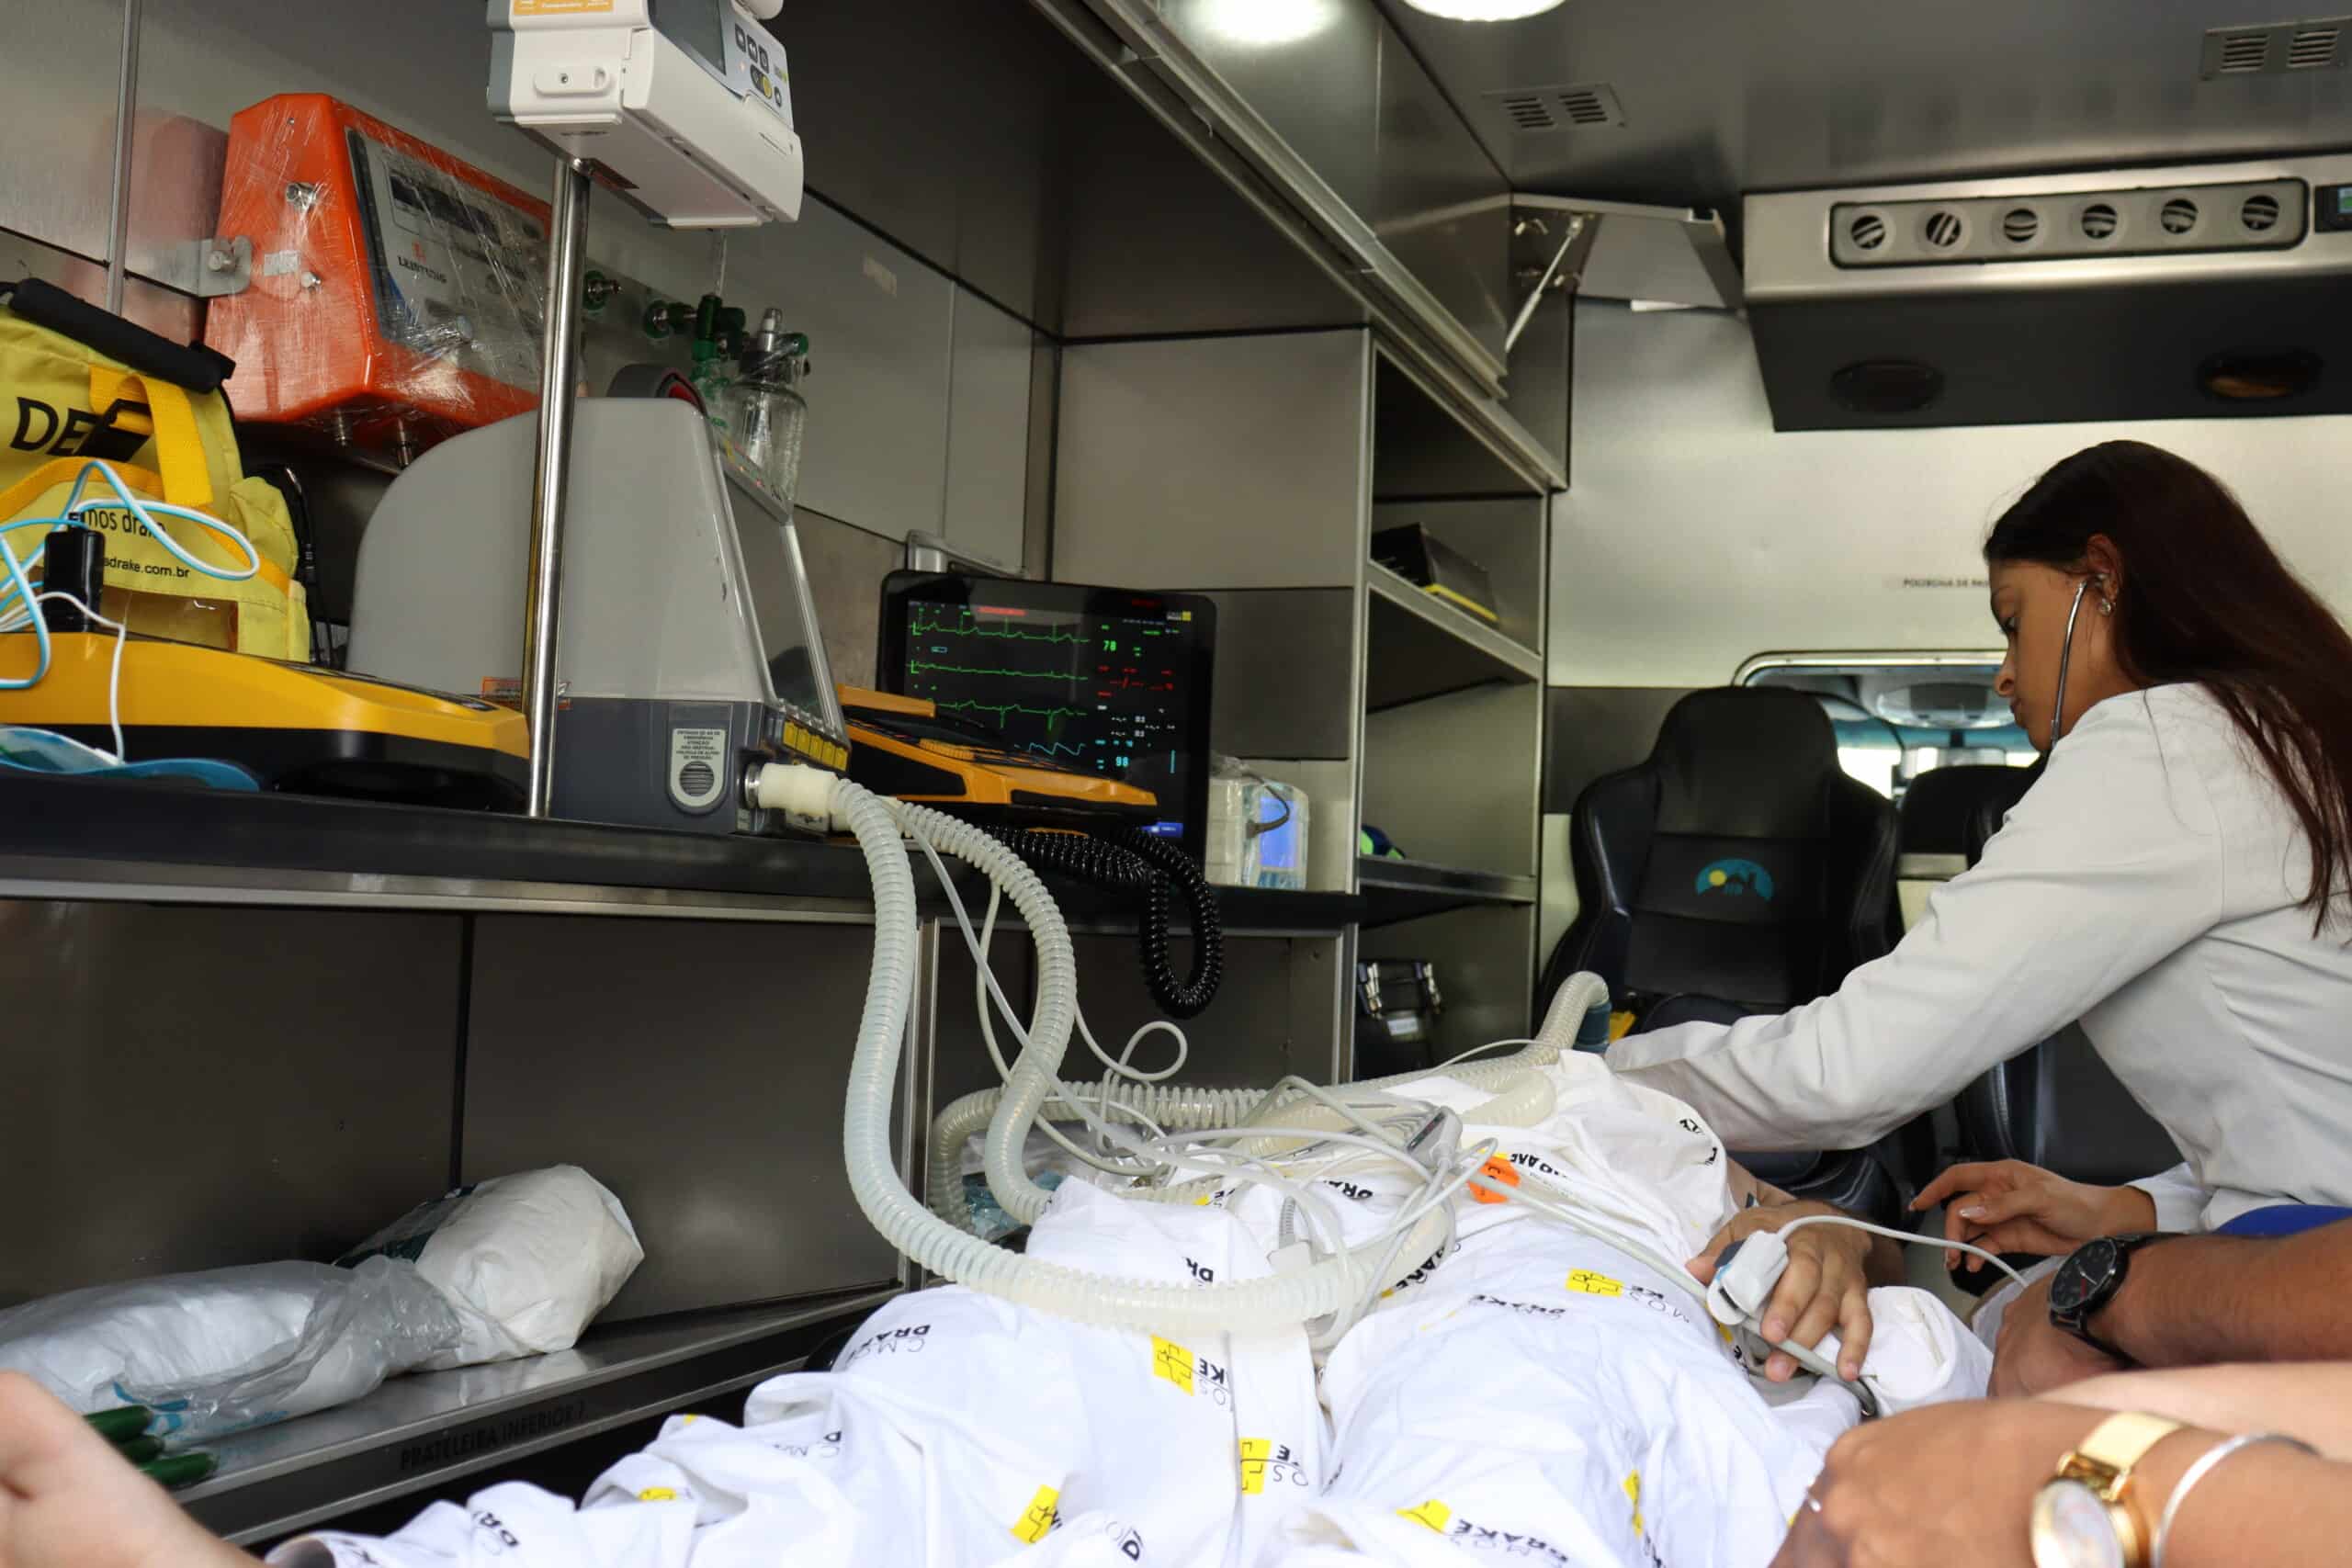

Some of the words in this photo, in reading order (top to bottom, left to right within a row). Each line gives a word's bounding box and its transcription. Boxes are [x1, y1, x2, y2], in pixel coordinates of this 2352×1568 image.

[10, 397, 97, 456] DE
[122, 507, 165, 538] dra
[104, 557, 191, 578] sdrake.com.br
[1103, 640, 1117, 651] 78
